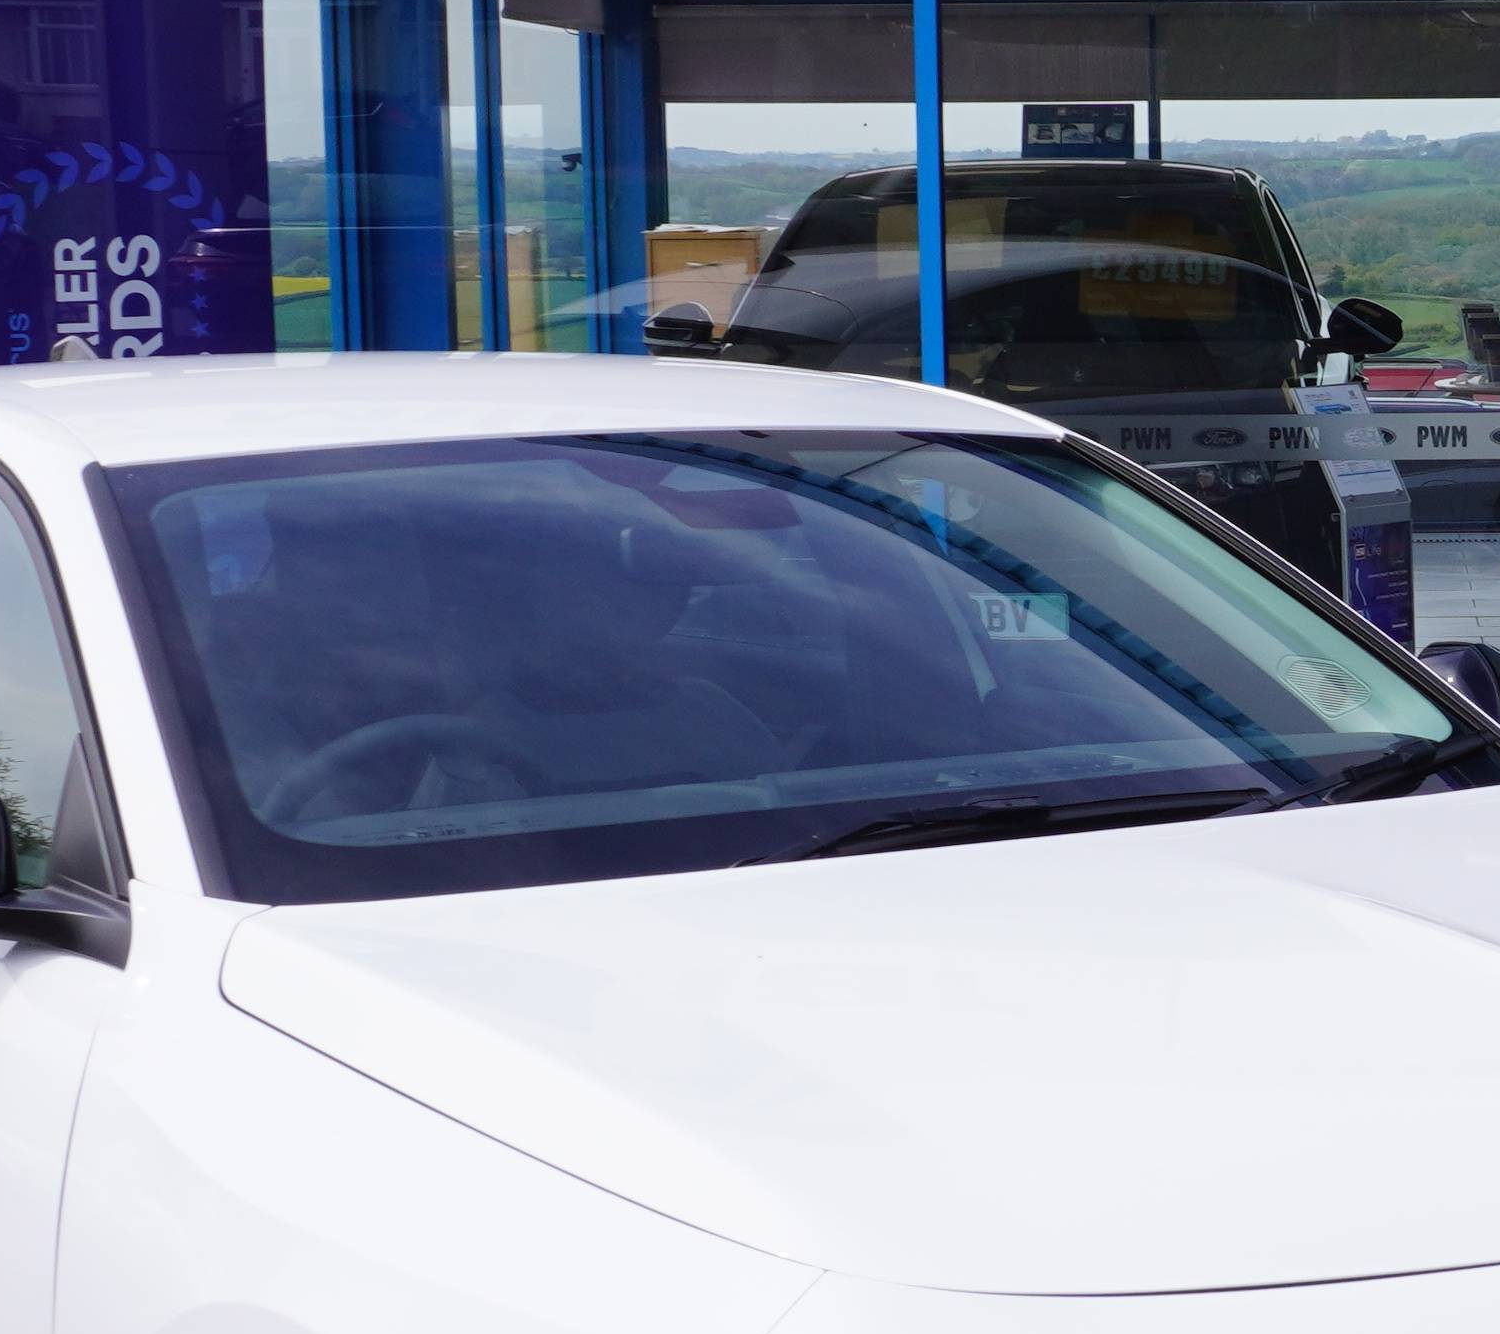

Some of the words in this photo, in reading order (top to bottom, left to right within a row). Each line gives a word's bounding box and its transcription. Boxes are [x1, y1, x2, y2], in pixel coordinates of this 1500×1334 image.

[1120, 426, 1172, 450] PWM
[1416, 425, 1469, 448] PWM
[984, 599, 1031, 634] BV
